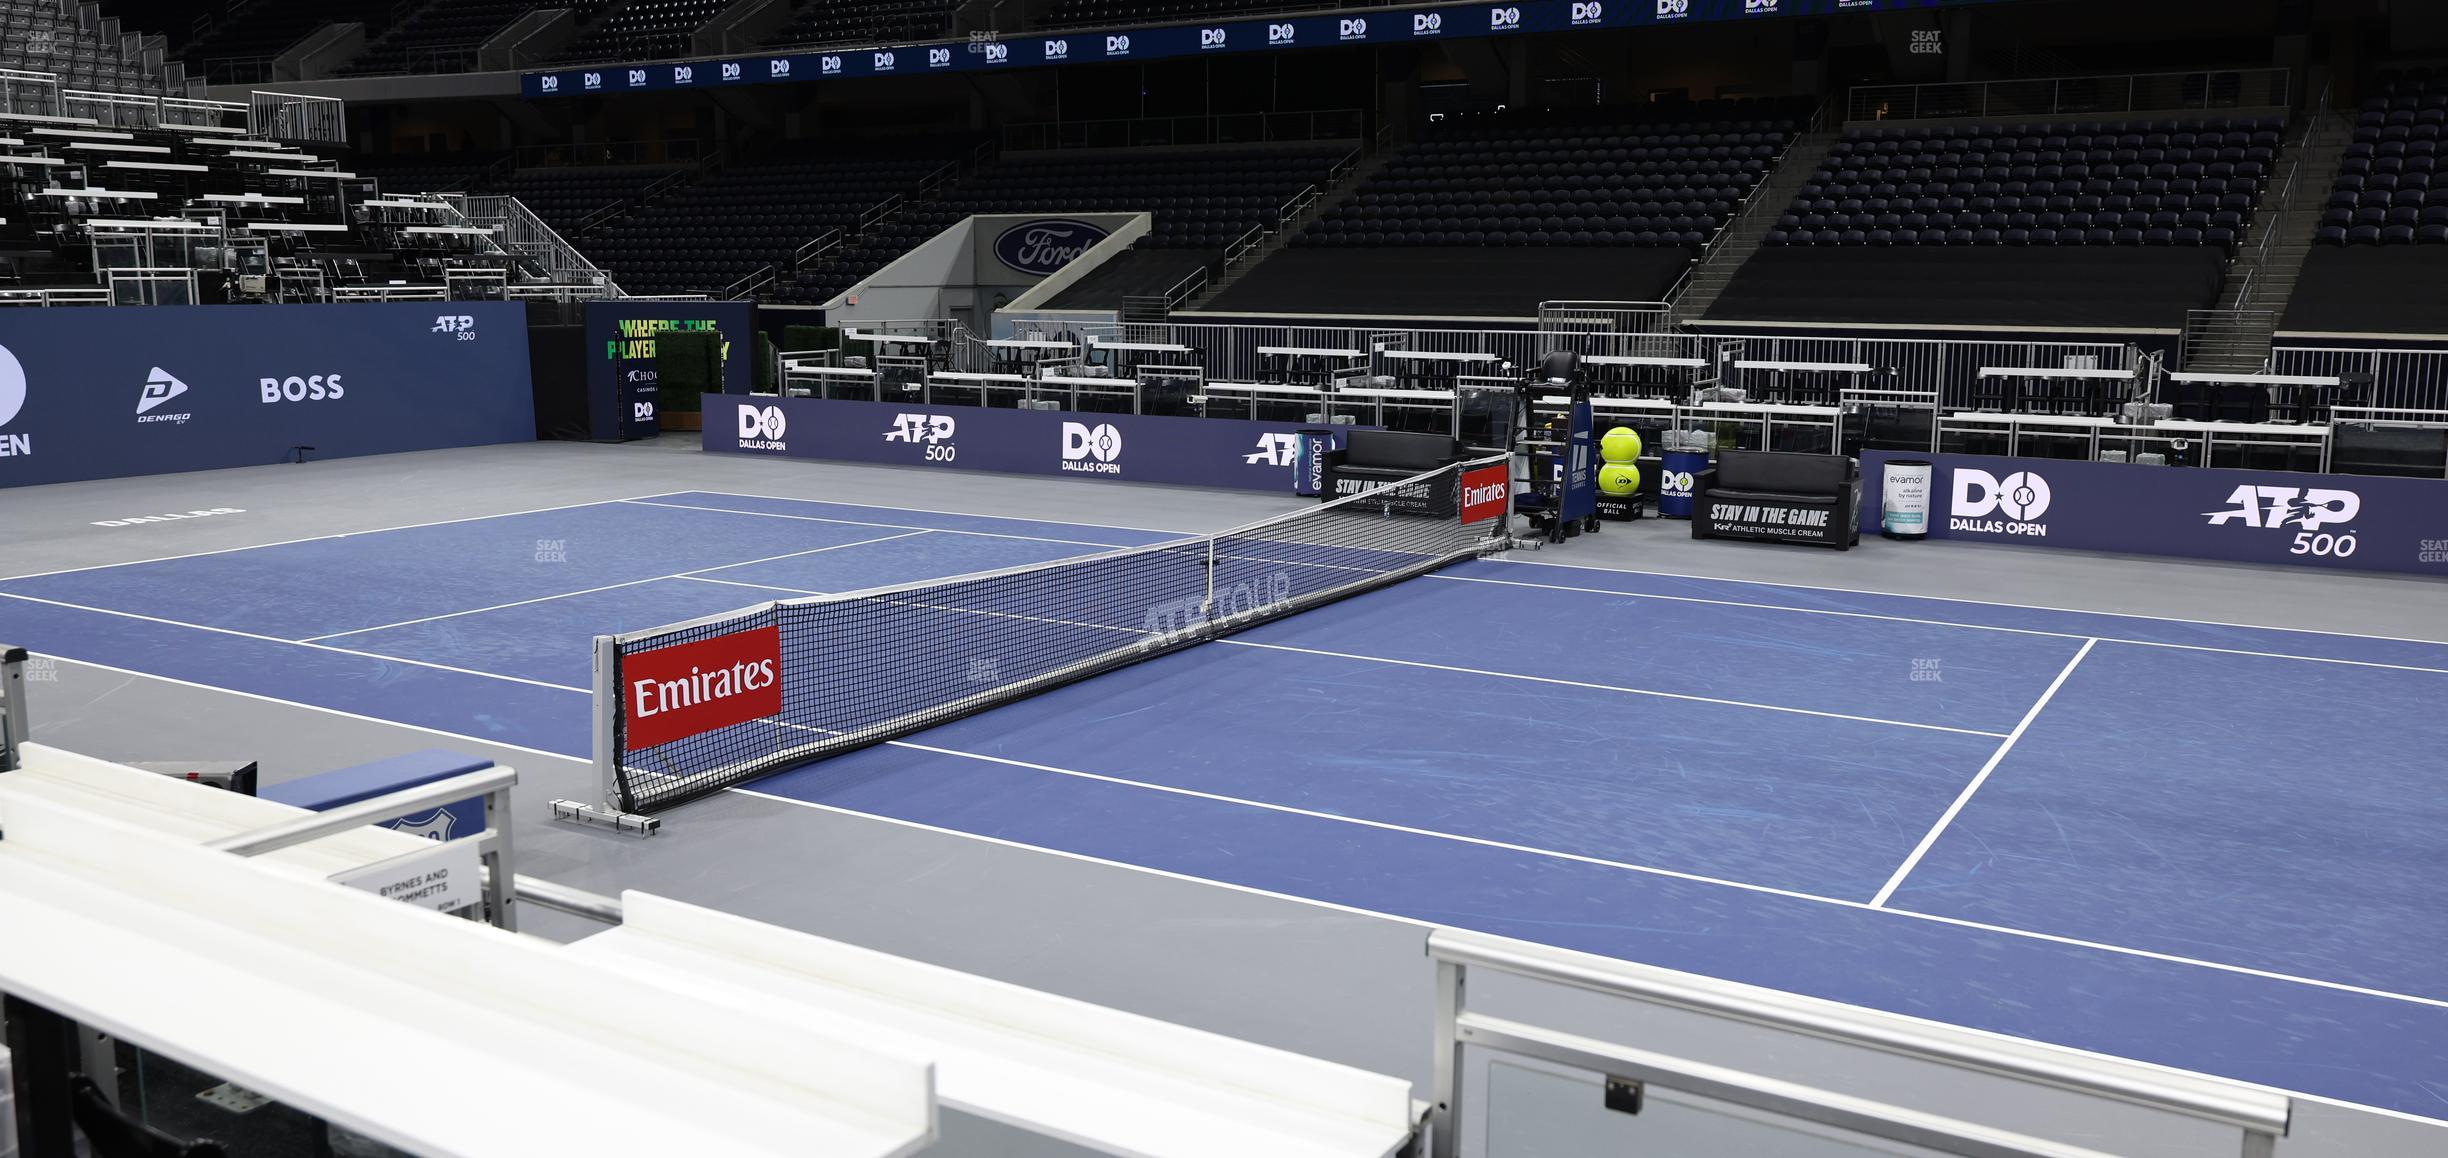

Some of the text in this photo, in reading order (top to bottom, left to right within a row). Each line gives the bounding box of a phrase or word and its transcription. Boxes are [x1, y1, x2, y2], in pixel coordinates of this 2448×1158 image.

[429, 315, 474, 332] ATP
[456, 331, 476, 341] 500
[260, 374, 345, 404] BOSS
[137, 413, 191, 423] DENAGO
[882, 412, 956, 444] ATP
[739, 439, 786, 451] DALLAS OPEN
[925, 444, 956, 462] 500
[1062, 460, 1120, 474] DALLAS OPEN
[1312, 438, 1322, 491] evamor
[1336, 478, 1362, 494] STAY
[1890, 476, 1923, 484] evamor
[1464, 482, 1506, 508] Emirates
[1596, 502, 1627, 510] OFFICIAL
[2200, 484, 2360, 531] ATP
[90, 507, 247, 527] DALLAS
[1710, 504, 1829, 527] STAY IN THE GAME
[1732, 525, 1766, 534] ATHLETIC
[1767, 528, 1796, 536] MUSCLE
[1950, 518, 2046, 536] DALLAS OPEN
[2290, 532, 2357, 558] 500
[633, 658, 774, 718] Emirates
[380, 868, 448, 896] BYRNES AND
[438, 899, 456, 910] ROW
